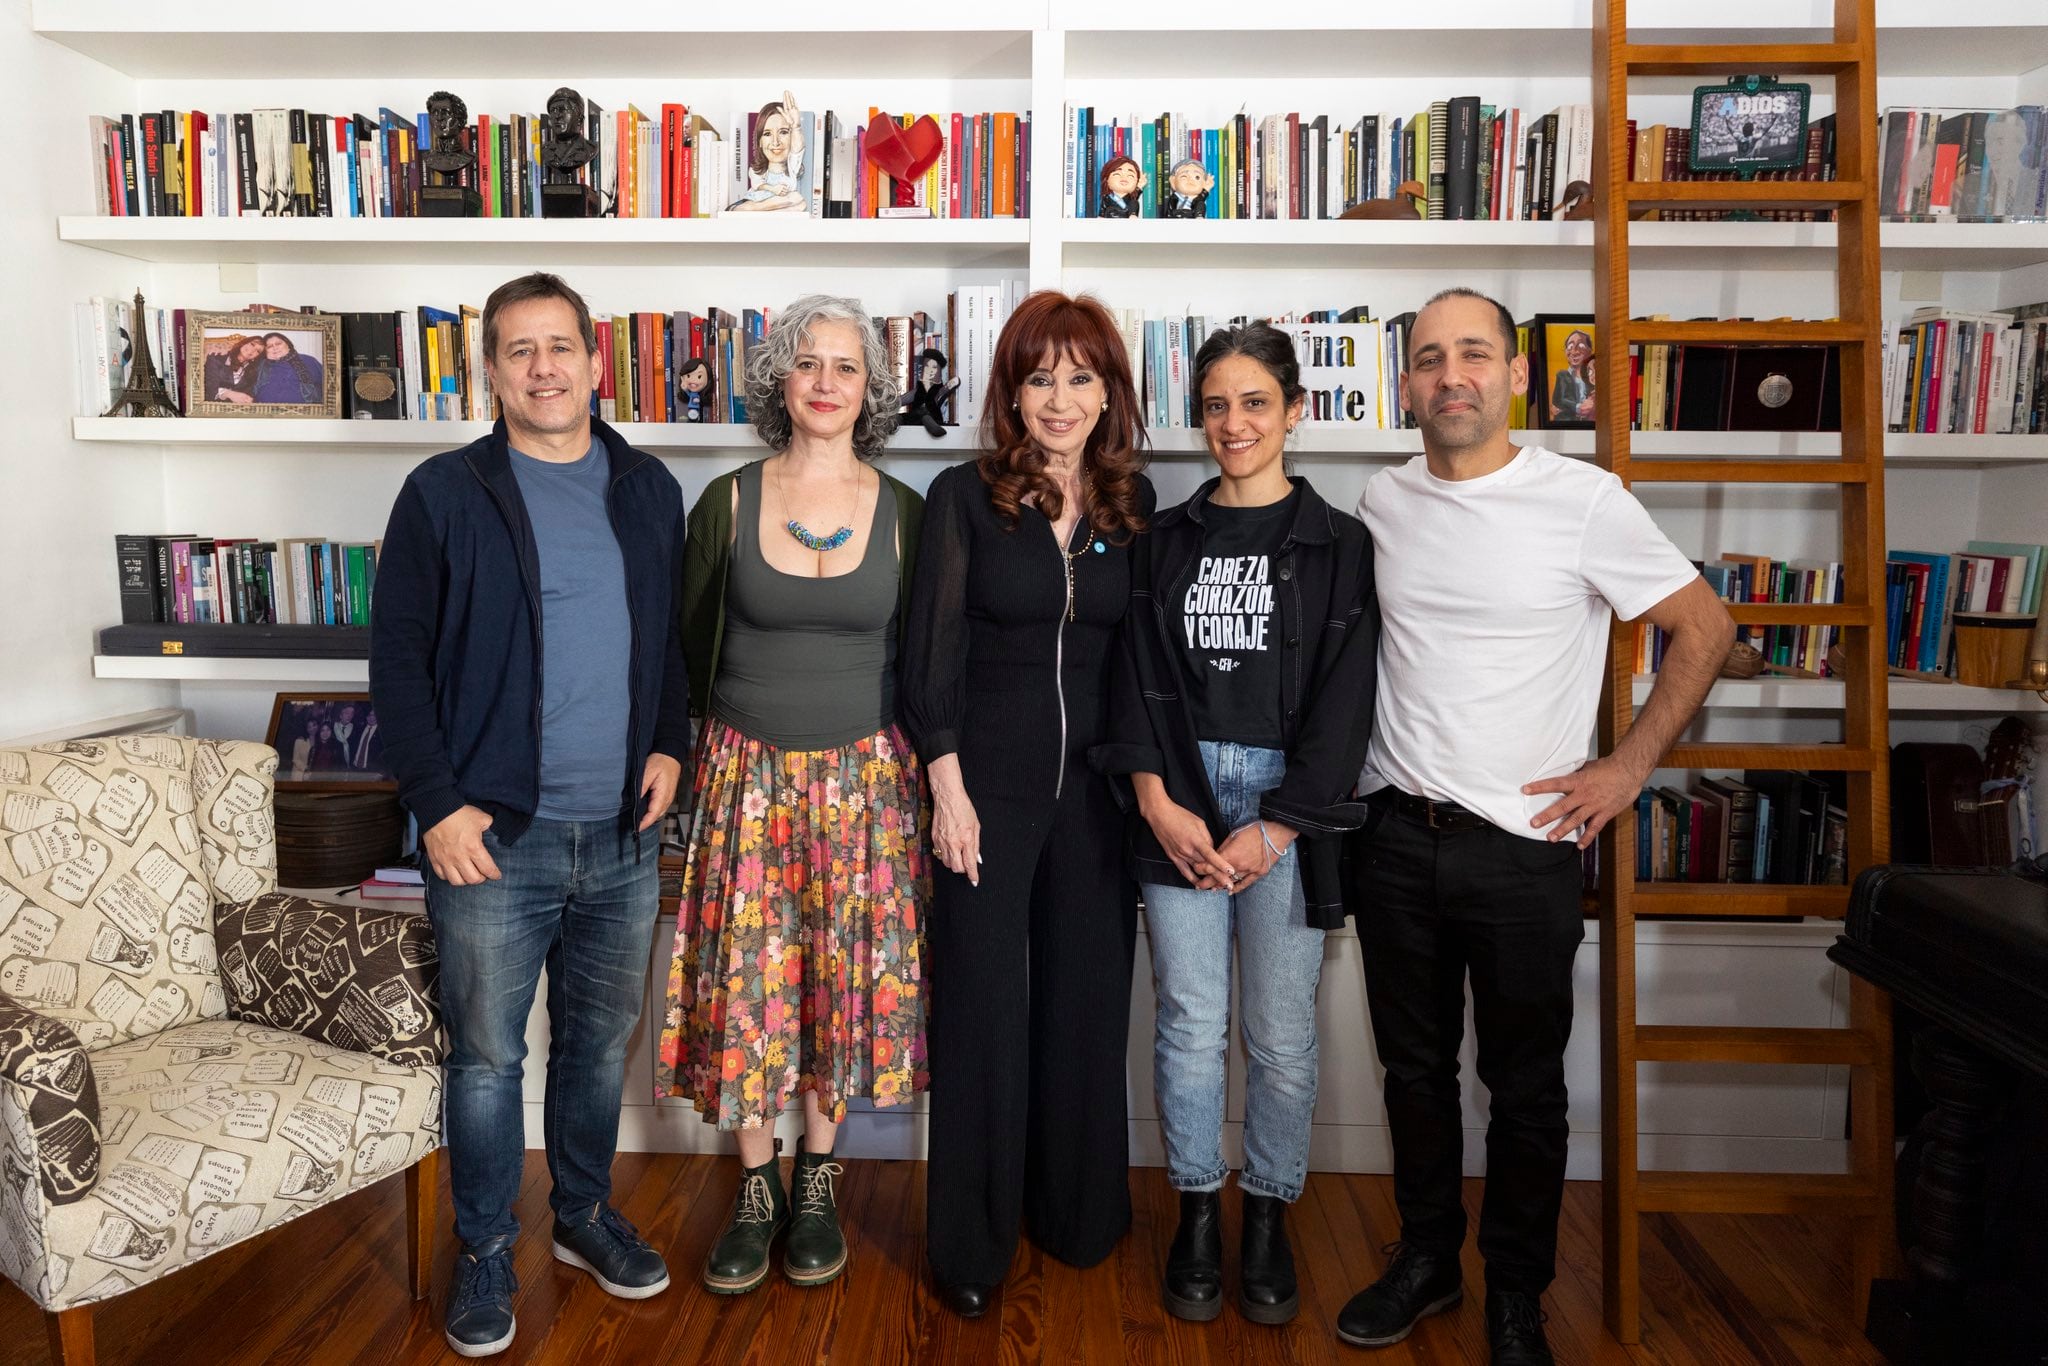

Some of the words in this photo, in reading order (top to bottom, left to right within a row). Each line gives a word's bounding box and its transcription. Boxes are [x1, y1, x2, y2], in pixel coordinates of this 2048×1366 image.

[1718, 95, 1789, 117] ADIOS
[145, 118, 156, 142] Indio
[2036, 168, 2046, 208] Argentina
[1172, 350, 1180, 383] GALIMBERTI
[1306, 385, 1365, 421] nte
[159, 546, 167, 587] CUMBRES
[1197, 555, 1269, 585] CABEZA
[1184, 616, 1195, 648] Y
[1198, 615, 1269, 650] CORAJE
[65, 878, 84, 892] Sirops
[182, 934, 192, 958] 173474
[15, 965, 30, 992] 173474
[208, 1160, 232, 1172] Sirops
[200, 1180, 230, 1197] Chocolat
